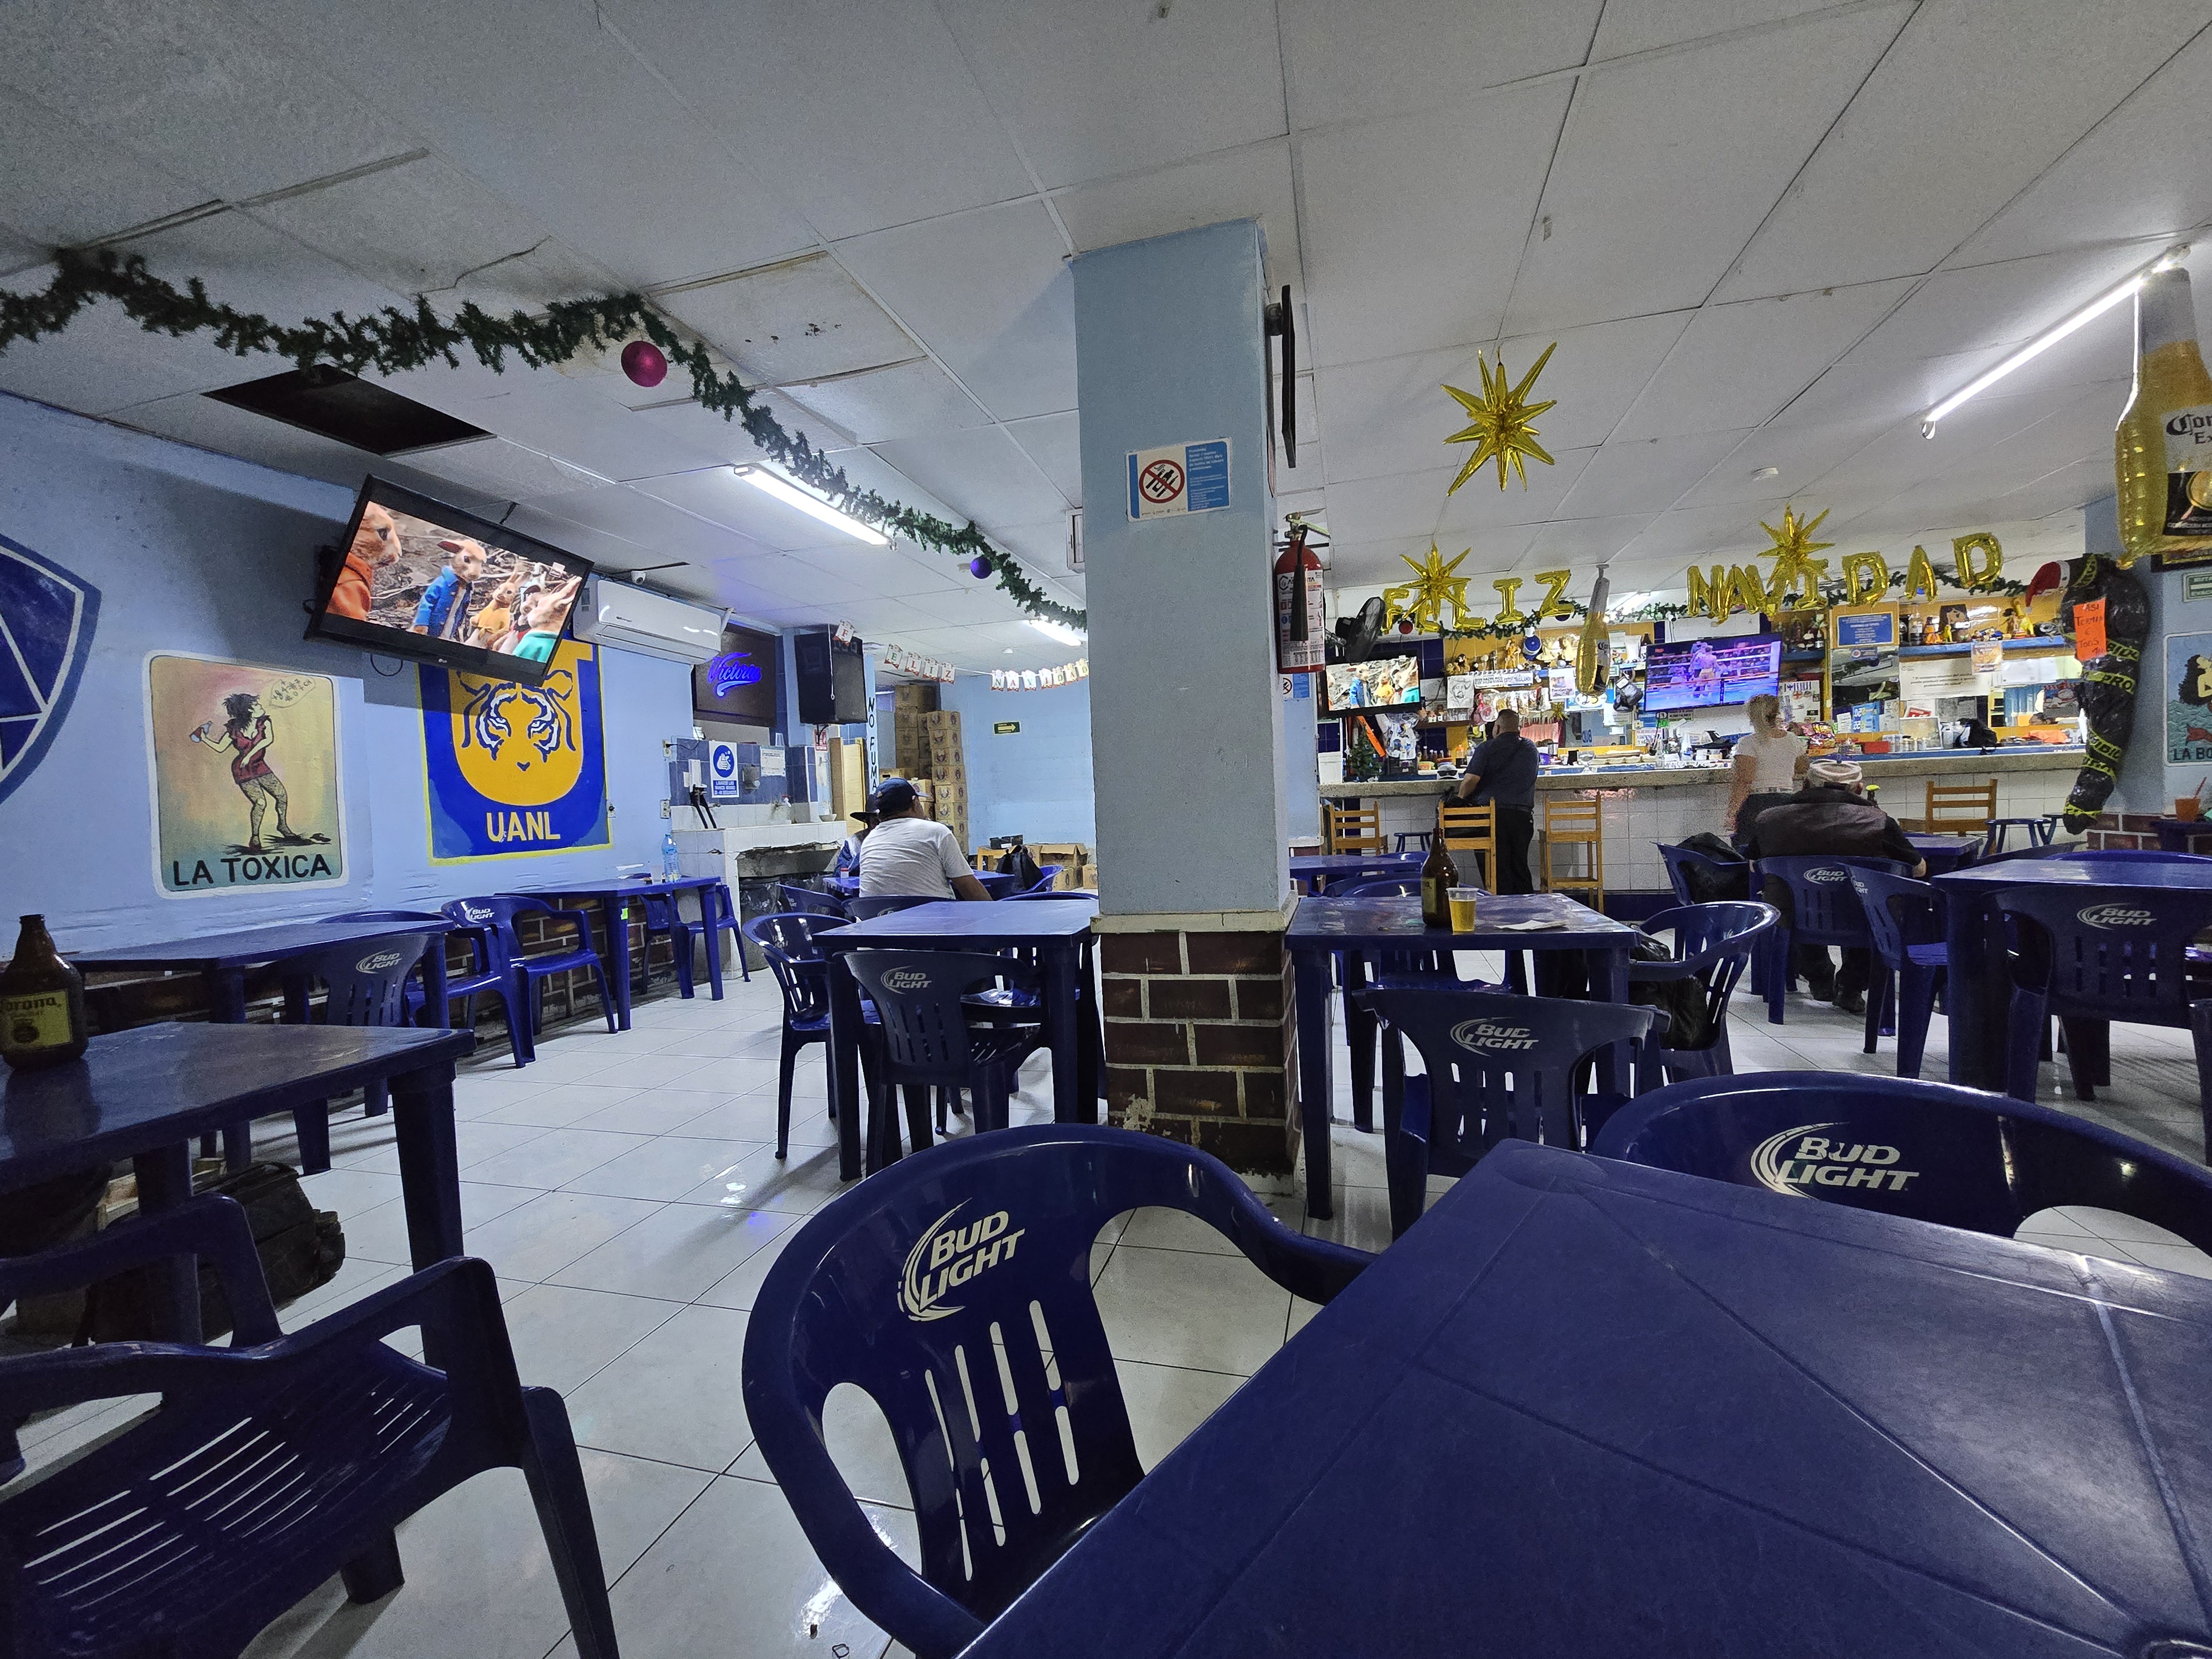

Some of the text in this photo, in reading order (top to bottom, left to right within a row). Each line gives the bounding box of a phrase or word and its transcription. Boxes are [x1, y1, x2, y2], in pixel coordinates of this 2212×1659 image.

[2173, 747, 2212, 761] LA BO
[487, 811, 561, 843] UANL
[173, 854, 332, 886] LA TOXICA
[2100, 907, 2151, 917] BUD
[2091, 916, 2157, 925] LIGHT
[364, 958, 402, 969] LIGHT
[372, 952, 400, 963] BUD
[894, 972, 926, 980] BUD
[888, 979, 932, 989] LIGHT
[1475, 1024, 1531, 1038] BUD
[1463, 1033, 1540, 1050] LIGHT
[1795, 1137, 1901, 1165] BUD
[1776, 1160, 1919, 1191] LIGHT
[930, 1211, 1009, 1270] BUD
[919, 1228, 1025, 1310] LIGHT
